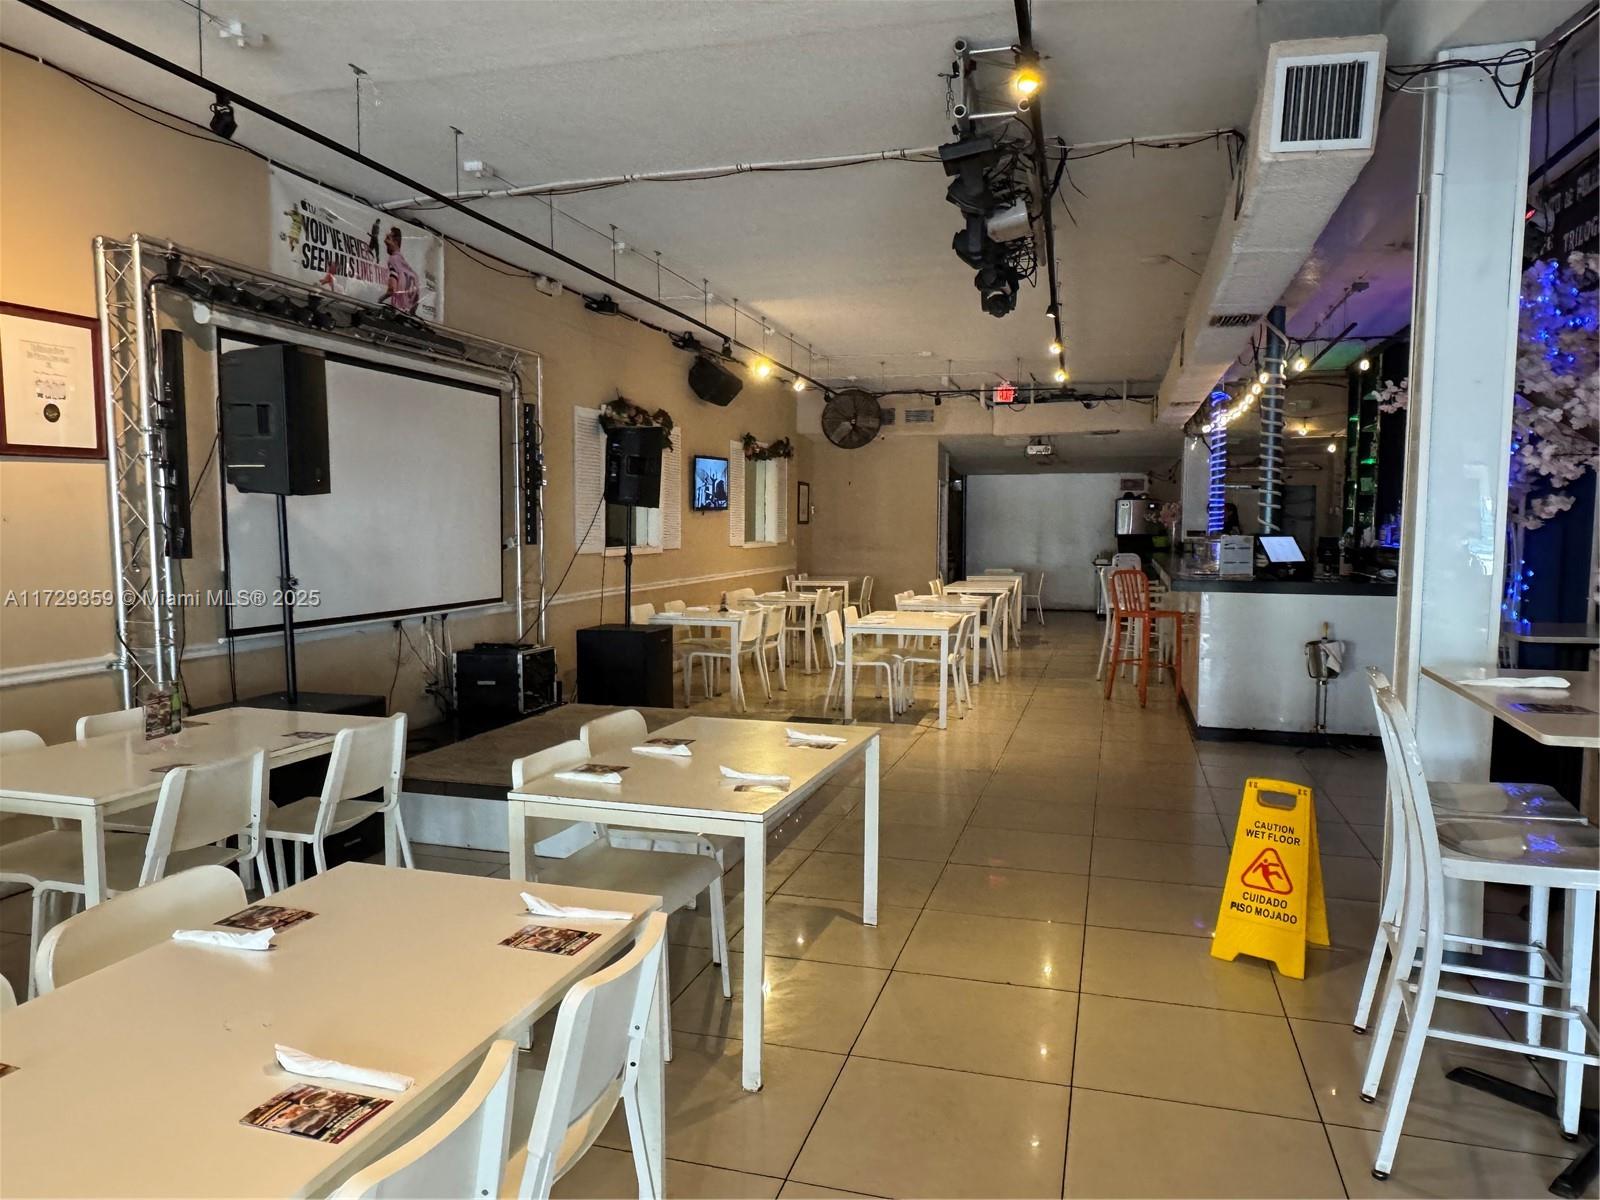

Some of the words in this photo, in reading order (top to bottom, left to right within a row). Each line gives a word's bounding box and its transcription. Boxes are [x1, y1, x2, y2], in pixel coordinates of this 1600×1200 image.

[302, 215, 344, 252] YOU'VE
[343, 232, 374, 262] NEVER
[302, 243, 333, 273] SEEN
[334, 252, 355, 279] MLS
[1246, 829, 1266, 841] WET
[1268, 832, 1301, 847] FLOOR
[1254, 820, 1295, 835] CAUTION
[1242, 891, 1288, 909] CUIDADO
[1230, 901, 1253, 914] PISO
[1254, 907, 1298, 925] MOJADO
